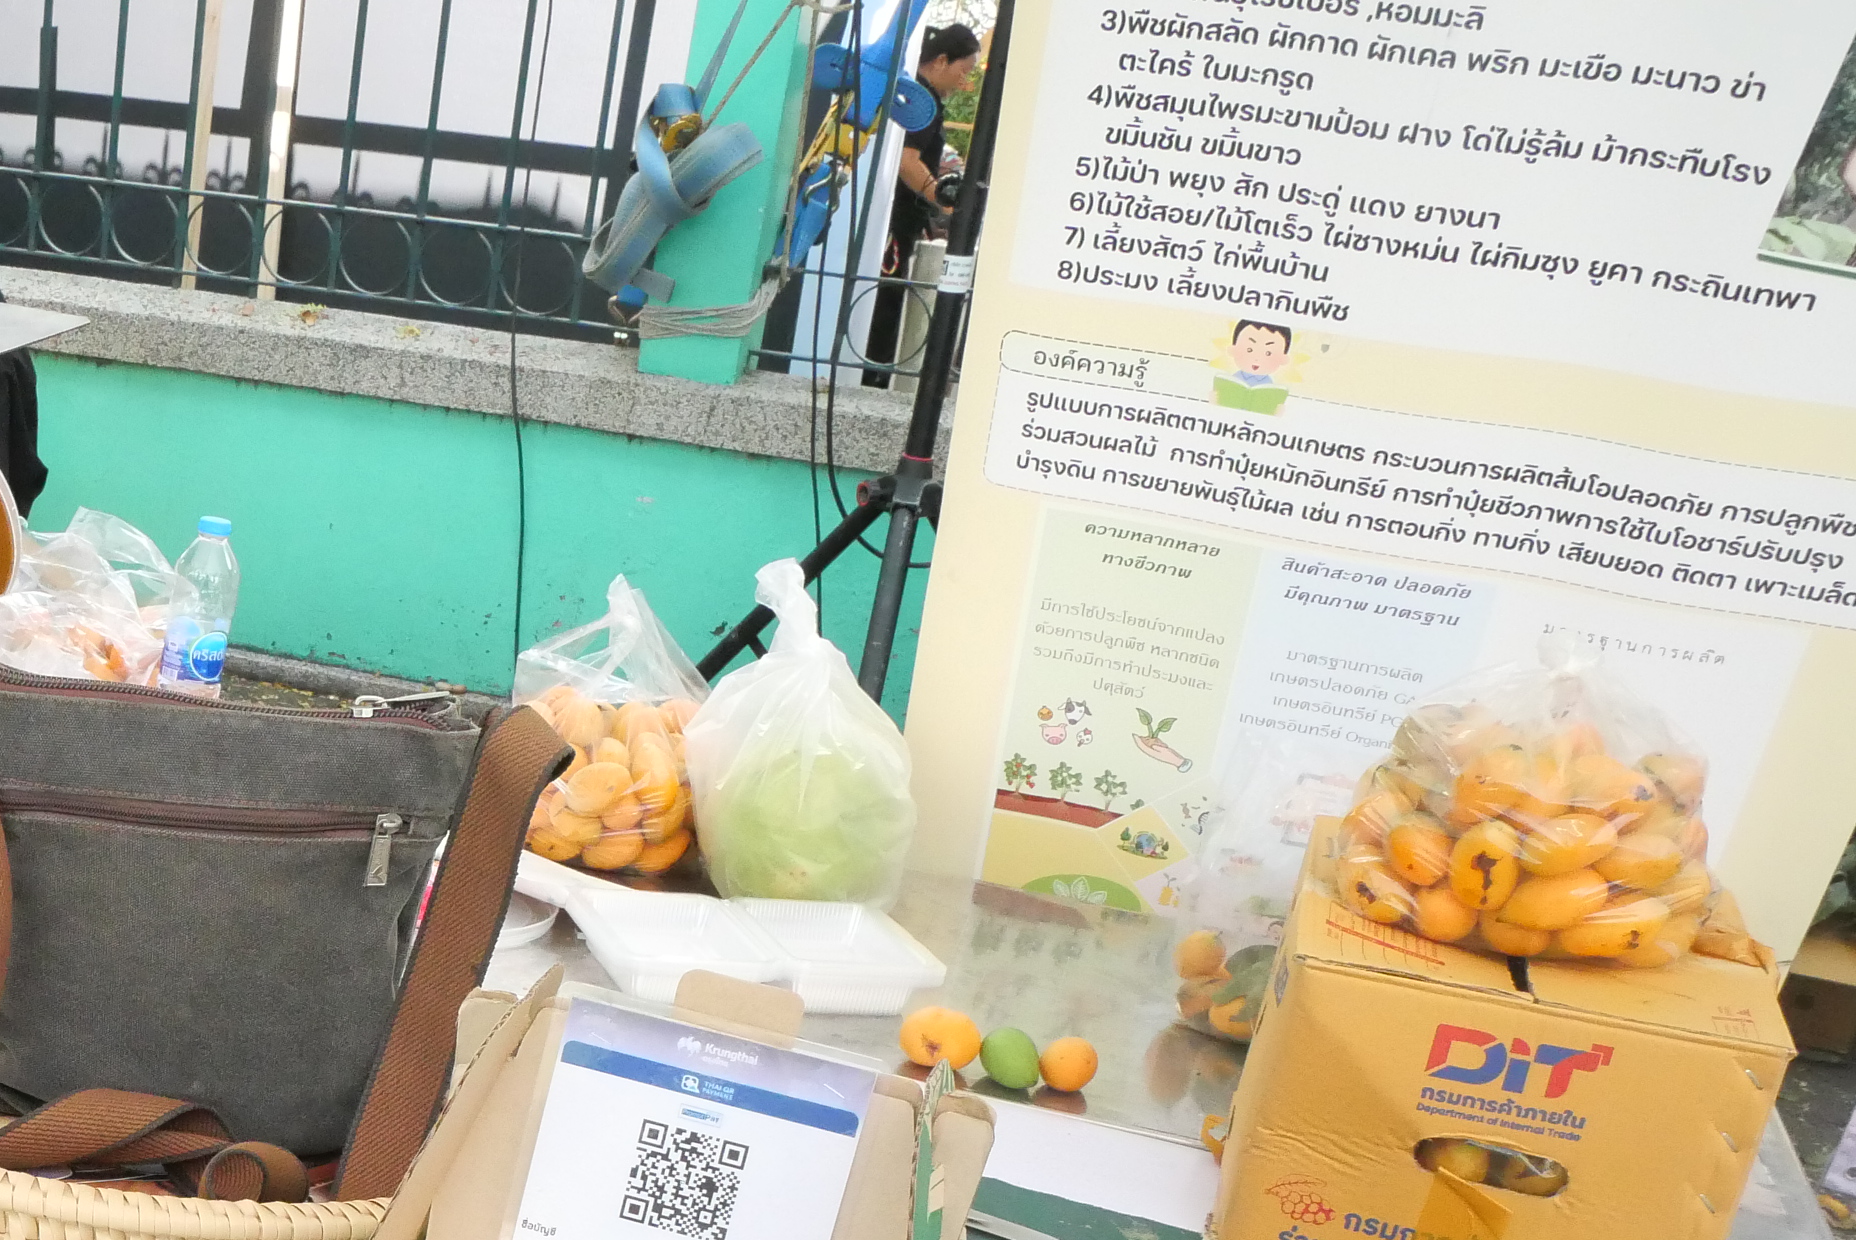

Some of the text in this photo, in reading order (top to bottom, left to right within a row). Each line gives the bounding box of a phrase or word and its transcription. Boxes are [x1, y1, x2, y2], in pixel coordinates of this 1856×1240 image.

[1100, 9, 1767, 102] 3)พืชผักสลัด ผักกาด ผักเคล พริก มะเขือ มะนาว ข่า
[1118, 48, 1314, 96] ตะไคร้ ใบมะกรูด
[1105, 117, 1302, 166] ขมิ้นชัน ขมิ้นขาว
[1398, 122, 1452, 149] ฝาง
[1462, 124, 1584, 165] โด่ไม่รู้ล้ม
[1591, 134, 1772, 186] ม้ากระทืบโรง
[1075, 155, 1501, 231] 5)ไม้ป่า พยุง สัก ประดู่ แดง ยางนา
[1063, 221, 1330, 283] 7) เลี้ยงสัตว์ ไก่พื้นบ้าน
[1322, 221, 1461, 265] ไผ่ซางหม่น
[1469, 240, 1580, 281] ไผ่กิมซุง
[1587, 259, 1644, 287] ยูคา
[1651, 269, 1817, 313] กระถินเทพา
[1056, 260, 1350, 322] 8)ประมง เลี้ยงปลากินพืช
[1033, 349, 1150, 388] องค์ความรู้
[1021, 417, 1158, 458] ร่วมสวนผลไม้
[1169, 446, 1387, 500] การทำปุ๋ยหมักอินทรีย์
[1372, 446, 1713, 517] กระบวนการผลิตส้มโอปลอดภัย
[1016, 451, 1096, 482] บำรุงดิน
[1102, 467, 1294, 518] การขยายพันธุ์ไม้ผล
[1301, 501, 1339, 526] เช่น
[1346, 510, 1466, 545] การตอนกิ่ง
[1473, 527, 1551, 557] ทาบกิ่ง
[1558, 539, 1664, 580] เสียบยอด
[1672, 561, 1737, 590] ติดตา
[1085, 521, 1221, 557] ความหลากหลาย
[1101, 551, 1193, 580] ทางชีวภาพ
[1281, 557, 1472, 600] สินค้าสะอาด ปลอดภัย
[1283, 586, 1461, 627] มีคุณภาพ มาตรฐาน
[1150, 645, 1220, 669] หลากชนิด
[1286, 650, 1424, 684] มาตรฐานการผลิต
[1269, 671, 1388, 701] เกษตรปลอดภัย
[1239, 712, 1343, 740] เกษตรอินทรีย์
[1273, 695, 1378, 722] เกษตรอินทรีย์
[704, 1042, 760, 1066] Krungthai
[1415, 1101, 1485, 1124] Department
[1419, 1085, 1588, 1130] กรมการค้าภายใน
